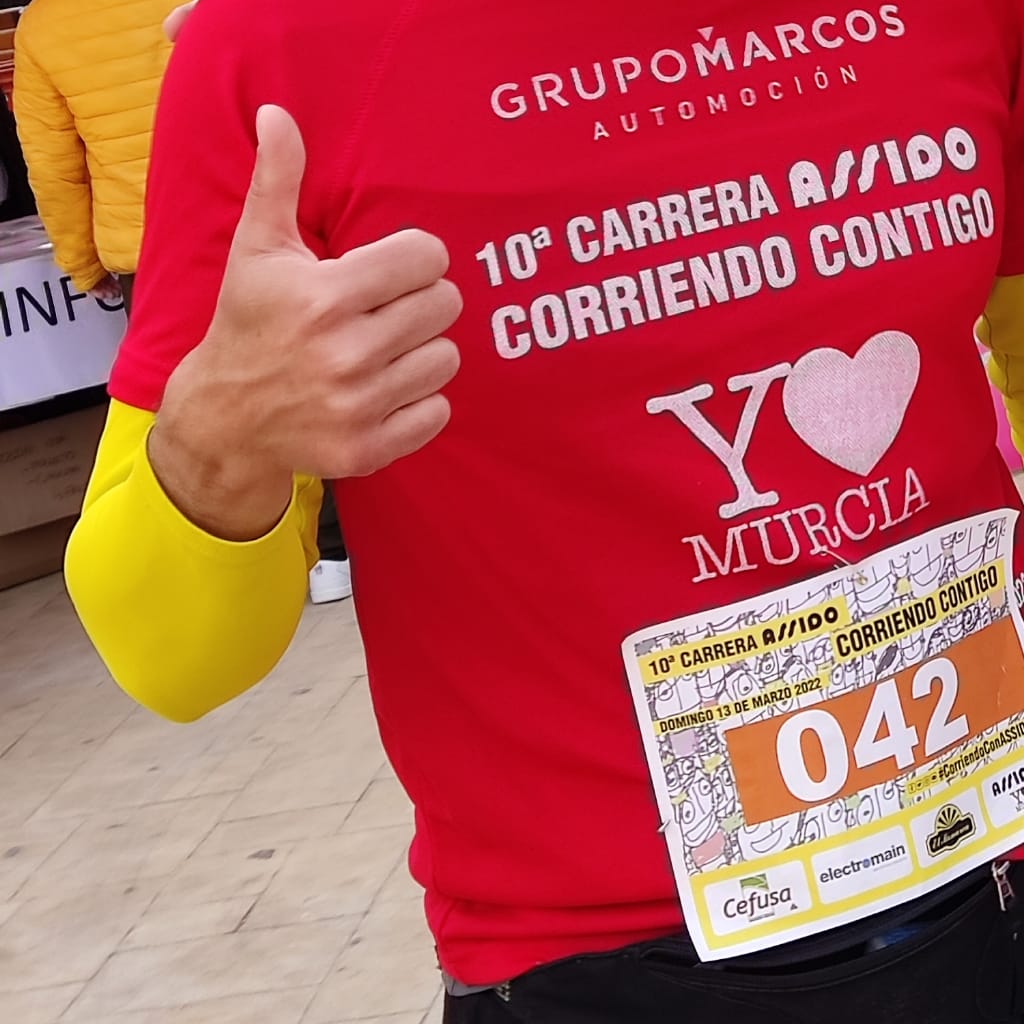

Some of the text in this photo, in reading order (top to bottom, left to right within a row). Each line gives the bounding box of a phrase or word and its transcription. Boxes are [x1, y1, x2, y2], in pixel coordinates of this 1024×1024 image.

[490, 4, 906, 119] GRUPOMARCOS
[593, 64, 858, 141] AUTOMOCIÓN
[475, 126, 977, 286] 10ª CARRERA ASSIDO
[490, 187, 996, 360] CORRIENDO CONTIGO
[645, 362, 793, 519] Y
[682, 466, 931, 584] MURCIA
[680, 634, 758, 669] CARRERA
[762, 606, 839, 646] ASSIDO
[836, 564, 999, 658] CORRIENDO CONTIGO
[659, 677, 823, 733] DOMINGO 13 DE MARZO 2022
[775, 657, 969, 804] 042
[723, 886, 792, 919] Cefusa
[820, 843, 906, 883] electromain
